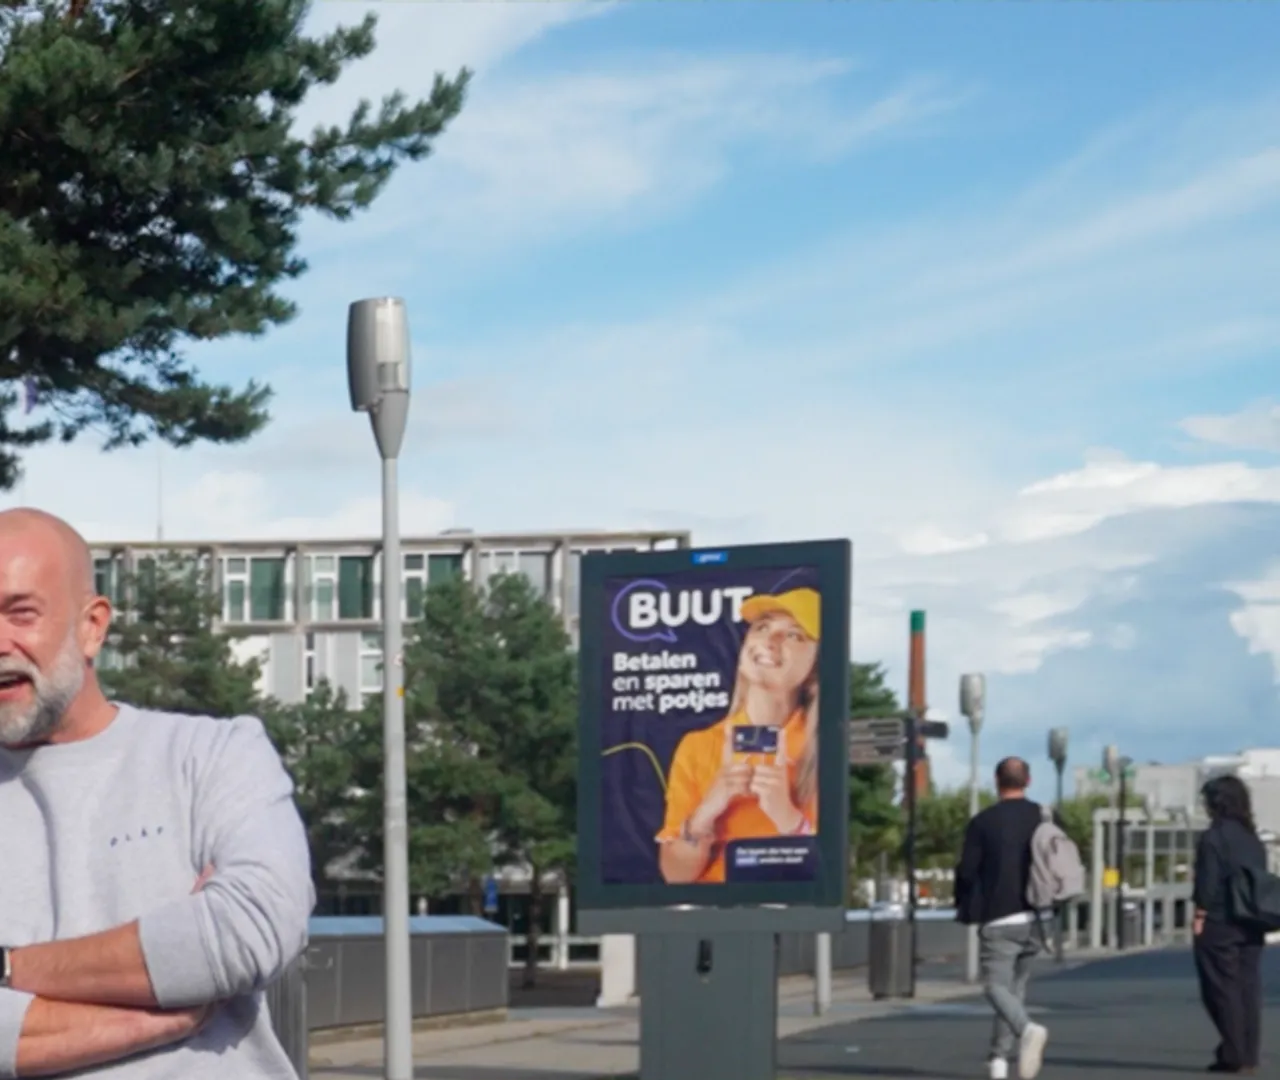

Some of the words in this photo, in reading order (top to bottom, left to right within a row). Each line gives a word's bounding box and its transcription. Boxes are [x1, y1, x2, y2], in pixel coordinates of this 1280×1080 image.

[628, 586, 754, 629] BUUT
[612, 650, 697, 672] Betalen
[612, 675, 639, 692] en
[644, 672, 720, 694] sparen
[612, 693, 654, 711] met
[658, 689, 729, 714] potjes
